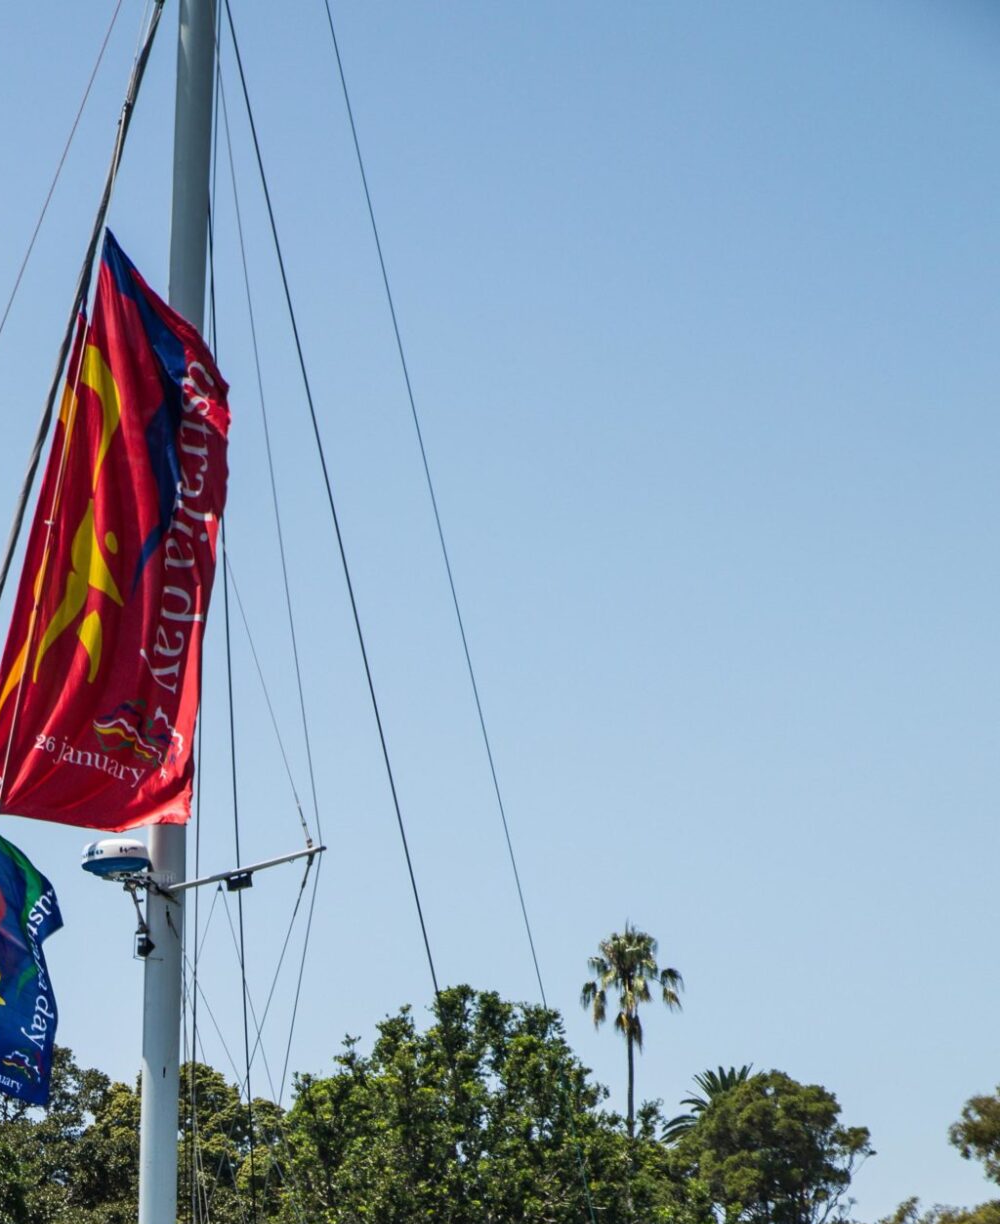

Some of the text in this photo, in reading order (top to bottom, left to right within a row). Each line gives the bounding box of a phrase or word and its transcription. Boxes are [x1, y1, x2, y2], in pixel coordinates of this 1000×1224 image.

[140, 585, 204, 694] day
[35, 734, 146, 788] 26 january
[21, 995, 54, 1050] day
